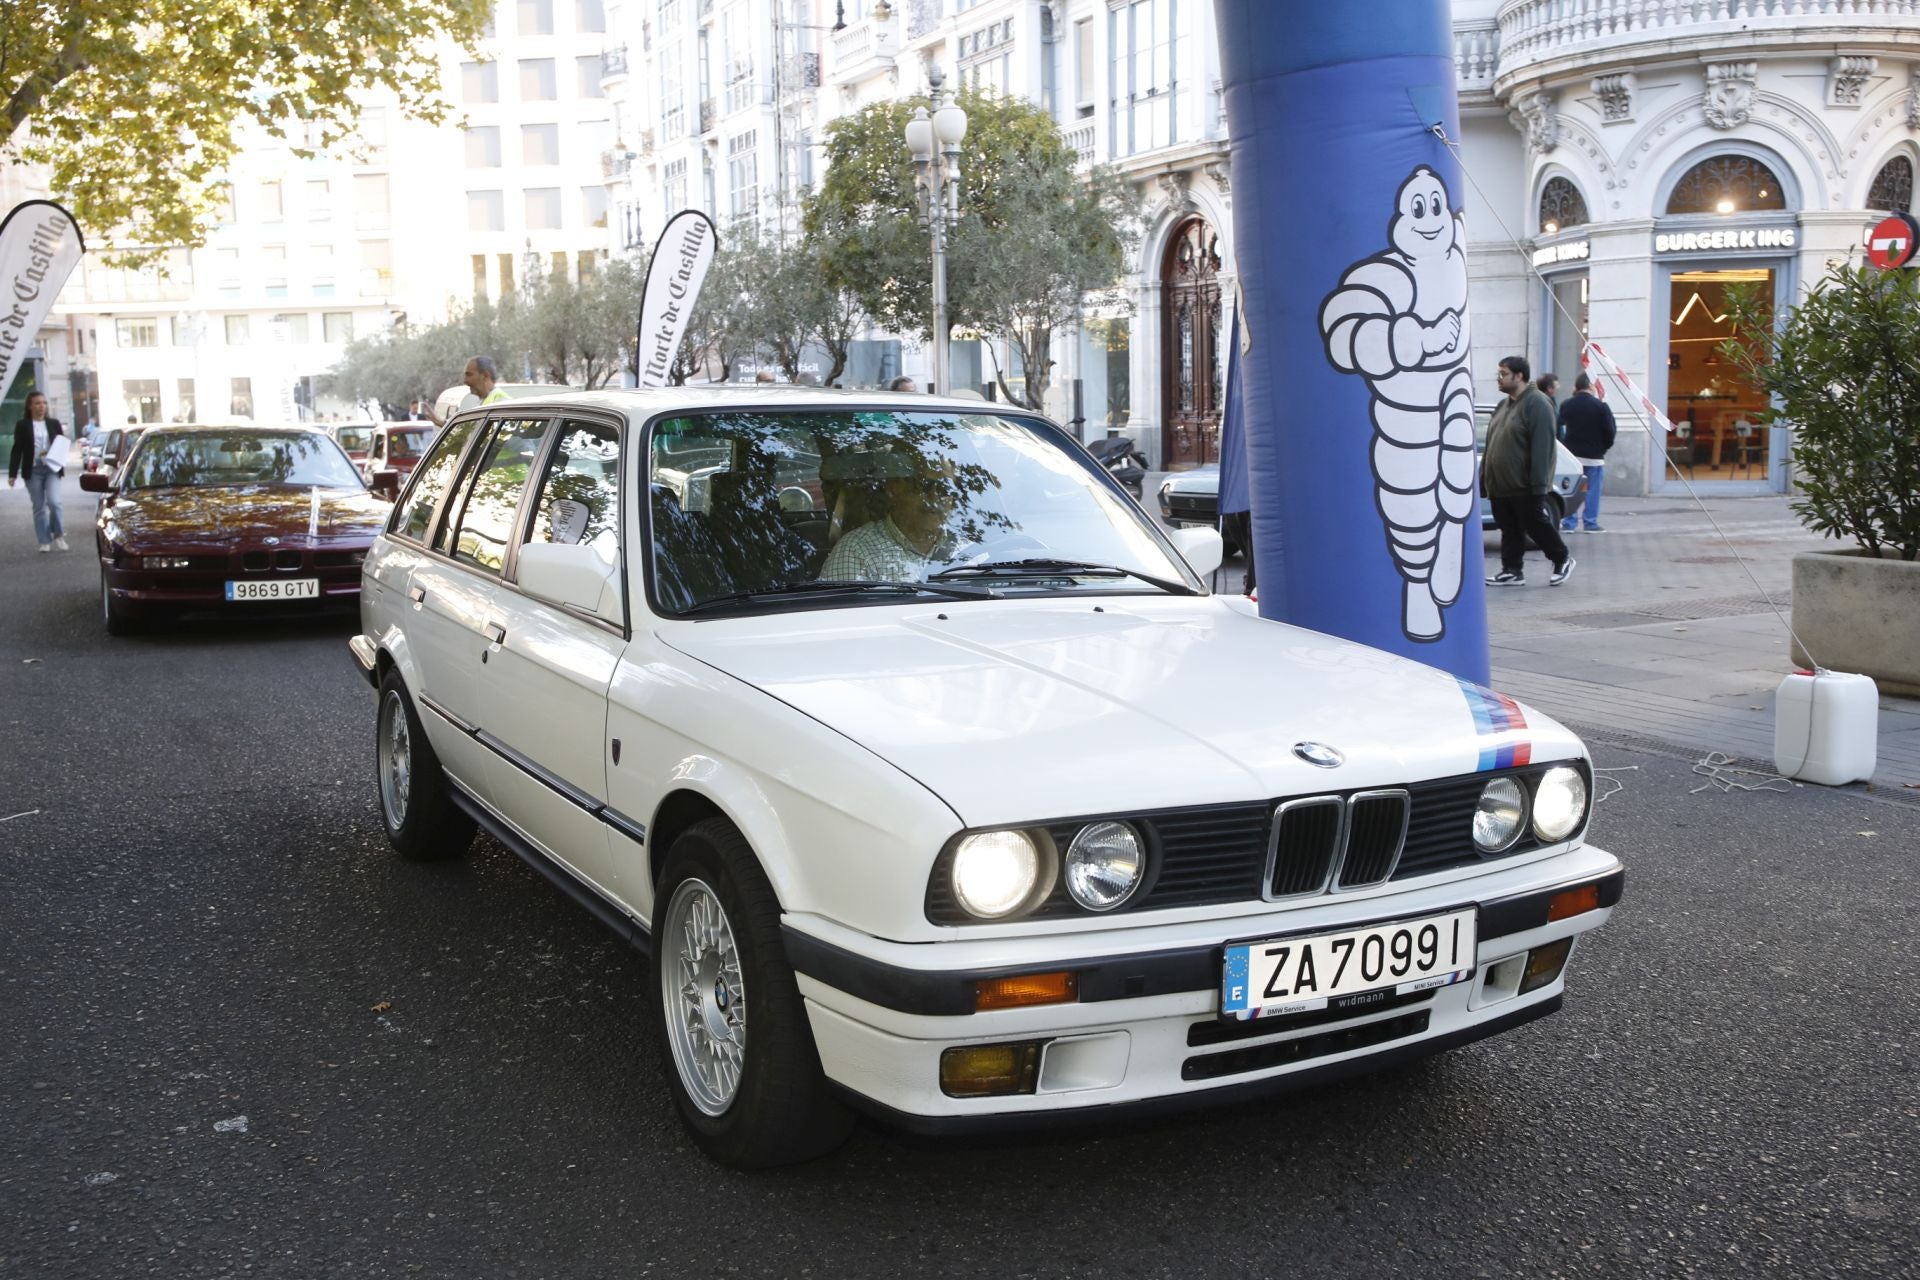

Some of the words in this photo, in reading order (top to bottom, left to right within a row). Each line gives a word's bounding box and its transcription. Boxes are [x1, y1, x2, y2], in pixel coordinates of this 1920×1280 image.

[1655, 231, 1738, 252] BURGER
[1739, 229, 1795, 248] KING
[13, 213, 70, 303] Castilla
[668, 220, 707, 301] Castilla
[0, 303, 30, 329] de
[660, 301, 681, 323] de
[645, 325, 674, 381] Norte
[237, 583, 279, 598] 9869
[285, 581, 315, 597] GTV
[1231, 985, 1243, 1001] E
[1414, 982, 1427, 991] MINI
[1427, 979, 1445, 989] Service
[1267, 1006, 1283, 1016] BMW
[1284, 1004, 1306, 1013] Service
[1338, 992, 1385, 1008] widmann
